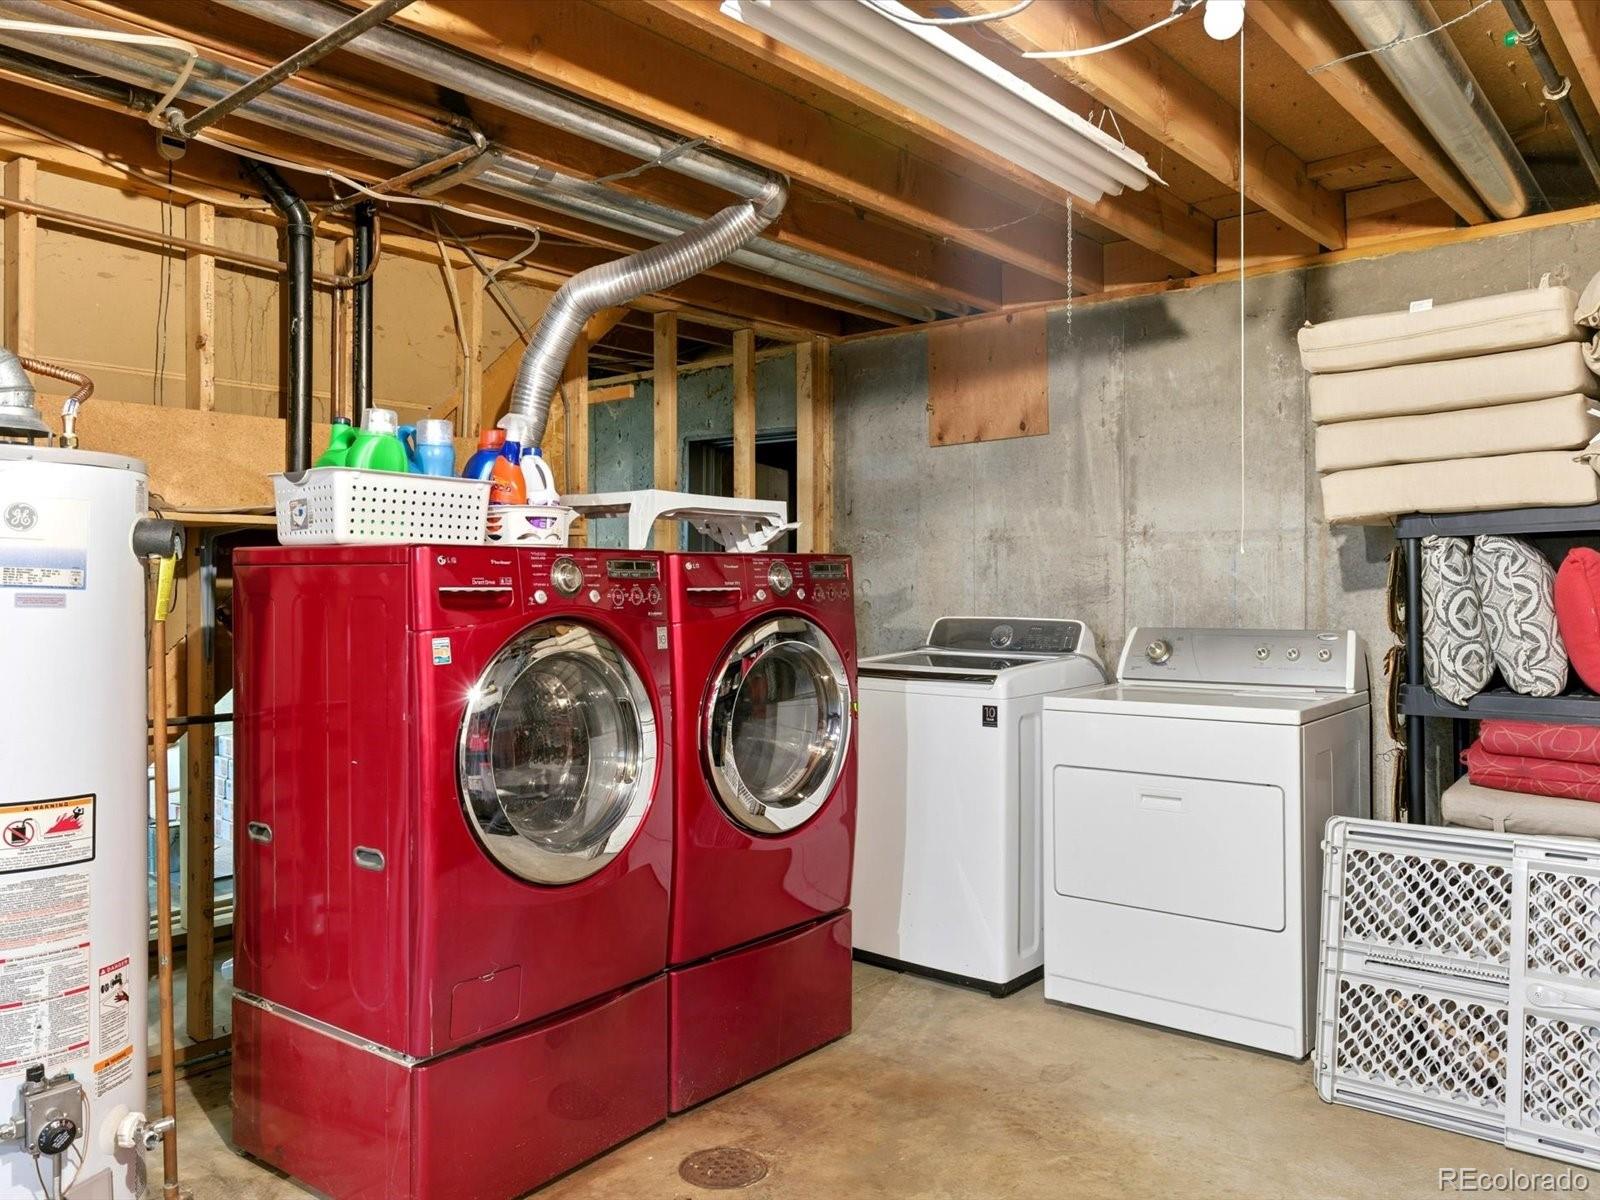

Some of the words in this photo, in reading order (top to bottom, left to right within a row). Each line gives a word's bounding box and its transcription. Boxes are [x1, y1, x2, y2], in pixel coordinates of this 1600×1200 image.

[984, 706, 996, 718] 10
[33, 802, 69, 811] WARNING
[106, 958, 129, 972] DANGER
